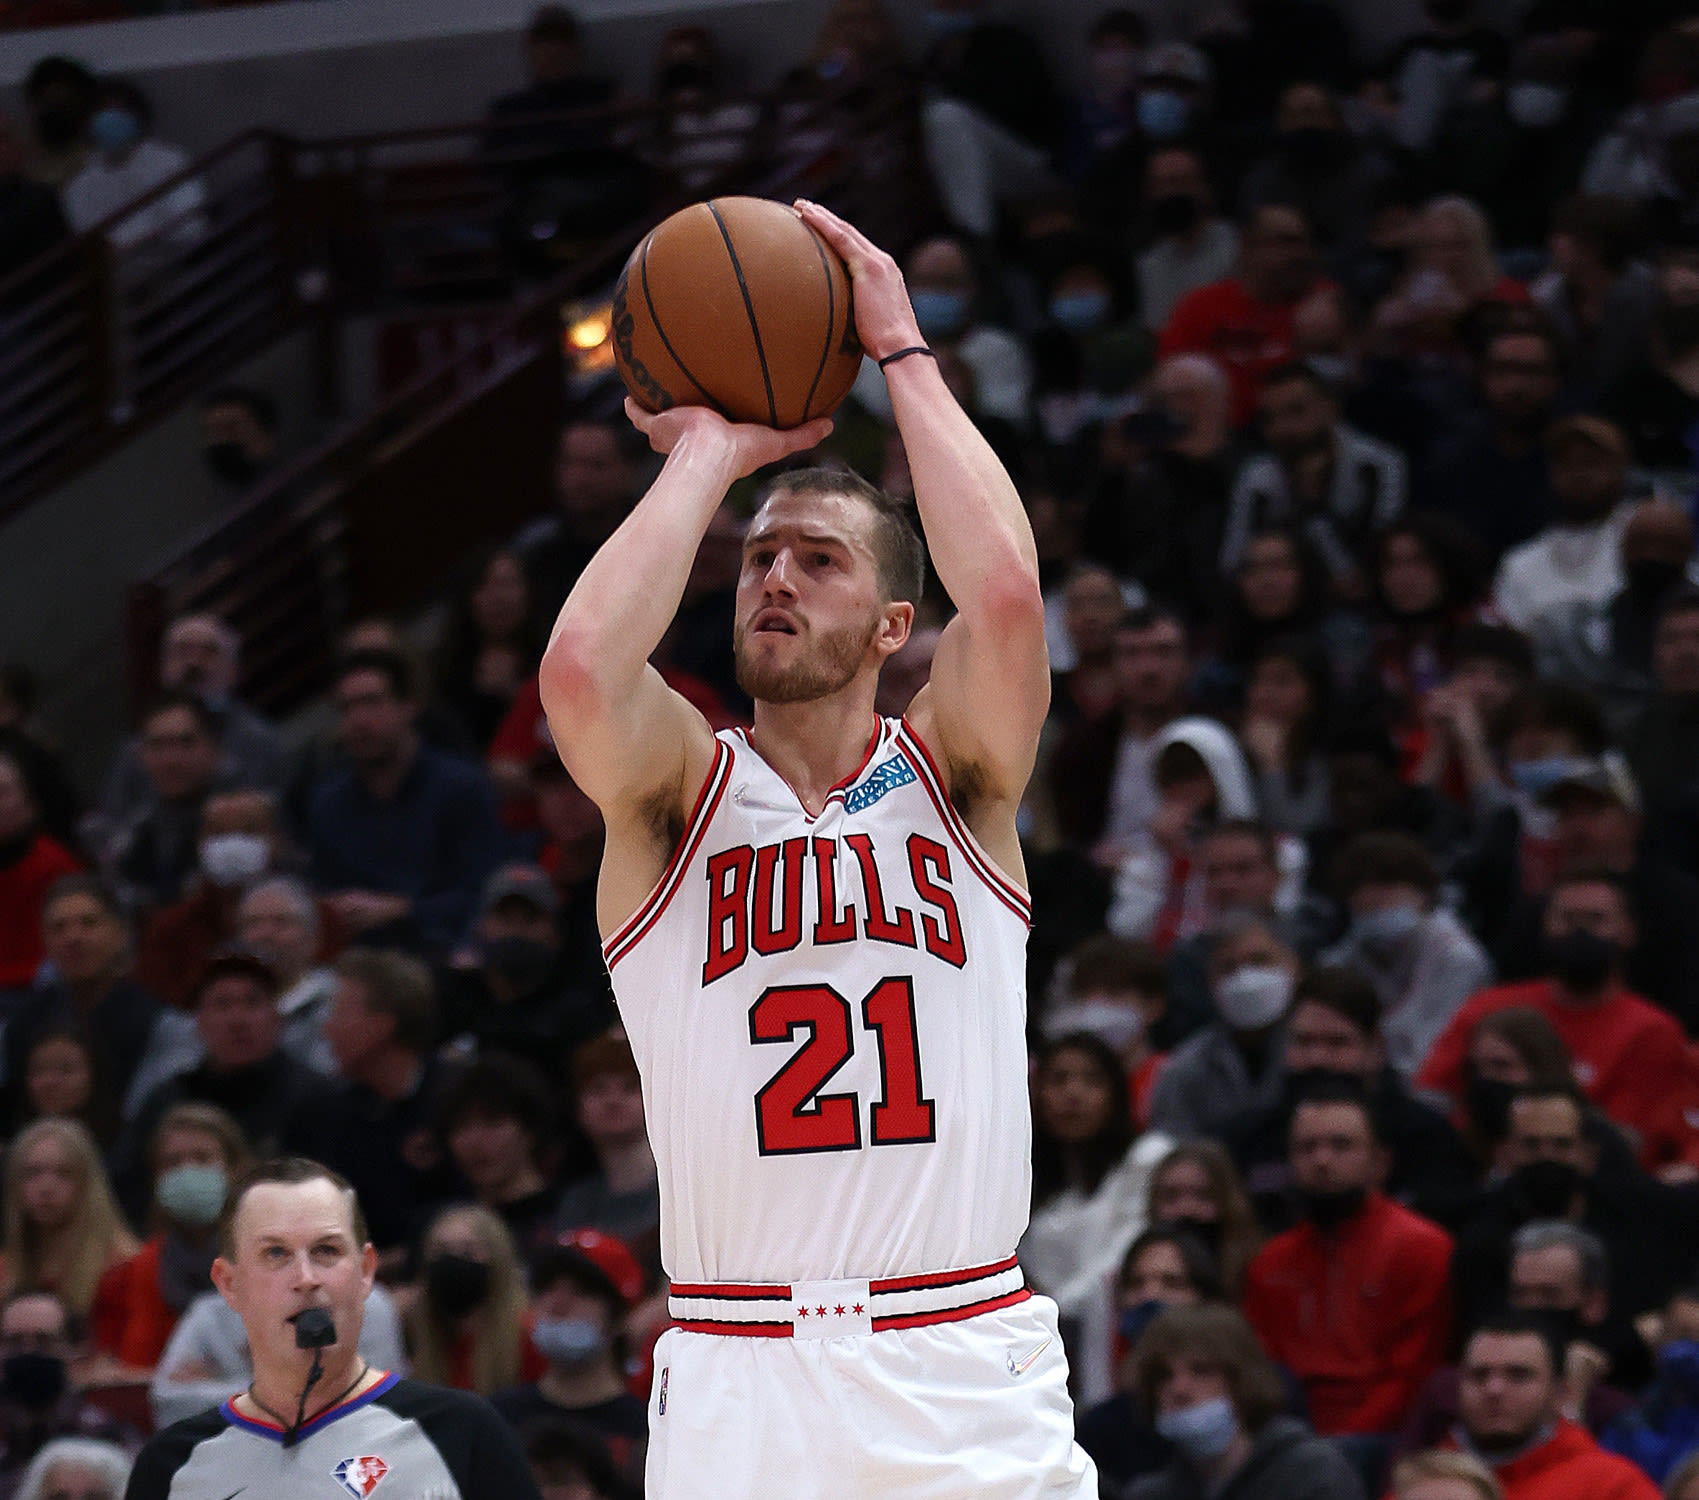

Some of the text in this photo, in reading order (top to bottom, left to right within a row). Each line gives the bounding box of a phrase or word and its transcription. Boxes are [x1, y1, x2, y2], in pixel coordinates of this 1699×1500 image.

[848, 771, 915, 813] EYEWEAR
[702, 832, 968, 988] BULLS
[748, 975, 937, 1157] 21
